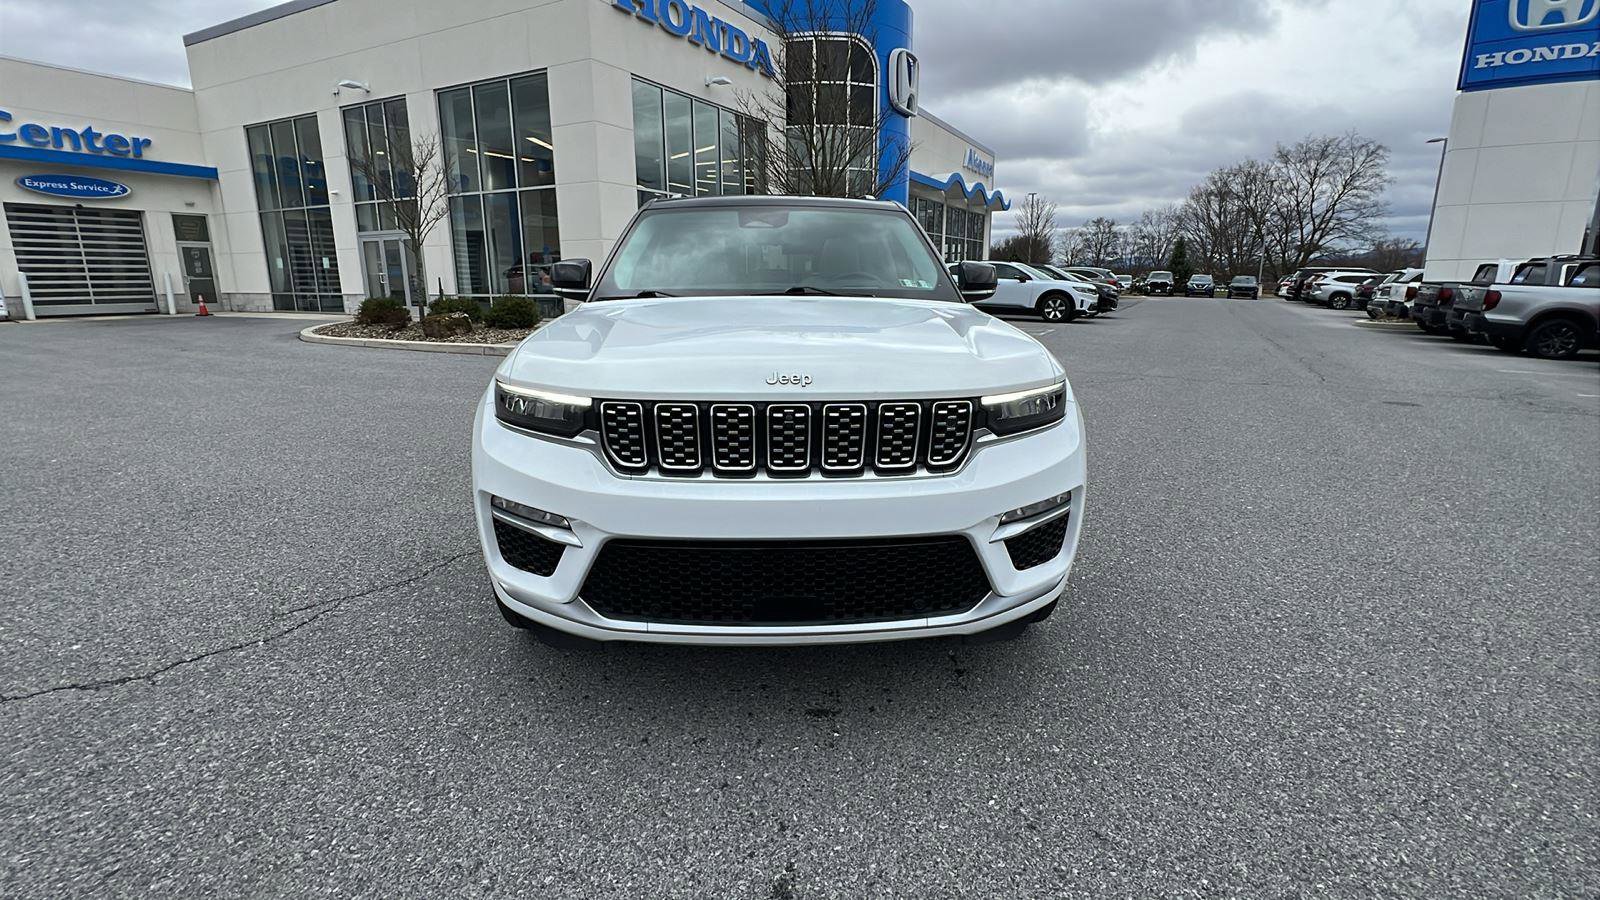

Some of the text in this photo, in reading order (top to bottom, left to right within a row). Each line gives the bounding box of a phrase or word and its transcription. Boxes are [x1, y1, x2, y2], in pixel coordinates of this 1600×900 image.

[25, 178, 109, 192] Express Service
[766, 371, 812, 387] Jeep
